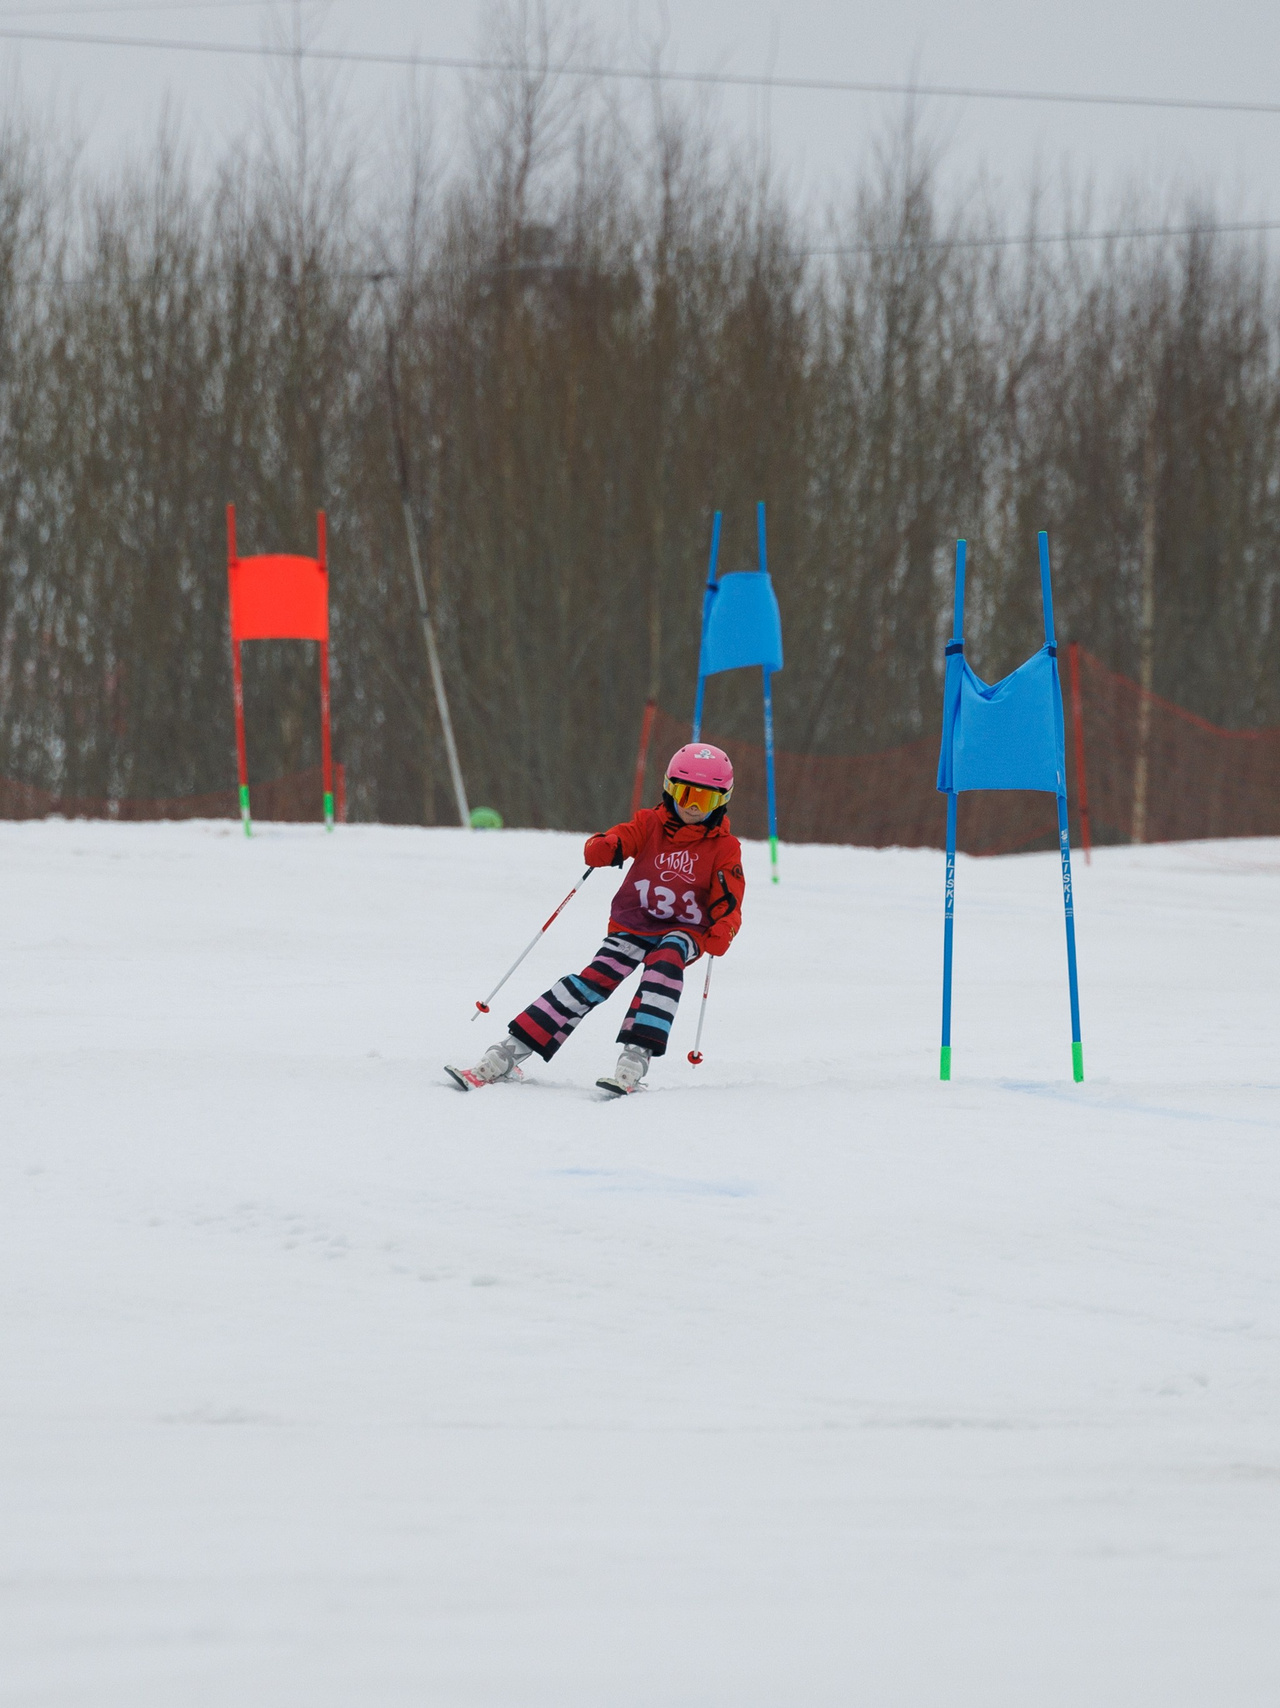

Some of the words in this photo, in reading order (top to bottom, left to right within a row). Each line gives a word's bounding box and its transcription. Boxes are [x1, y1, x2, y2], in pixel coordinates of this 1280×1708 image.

[634, 878, 703, 925] 133
[946, 859, 955, 908] LISKI
[1061, 853, 1071, 903] LISKI
